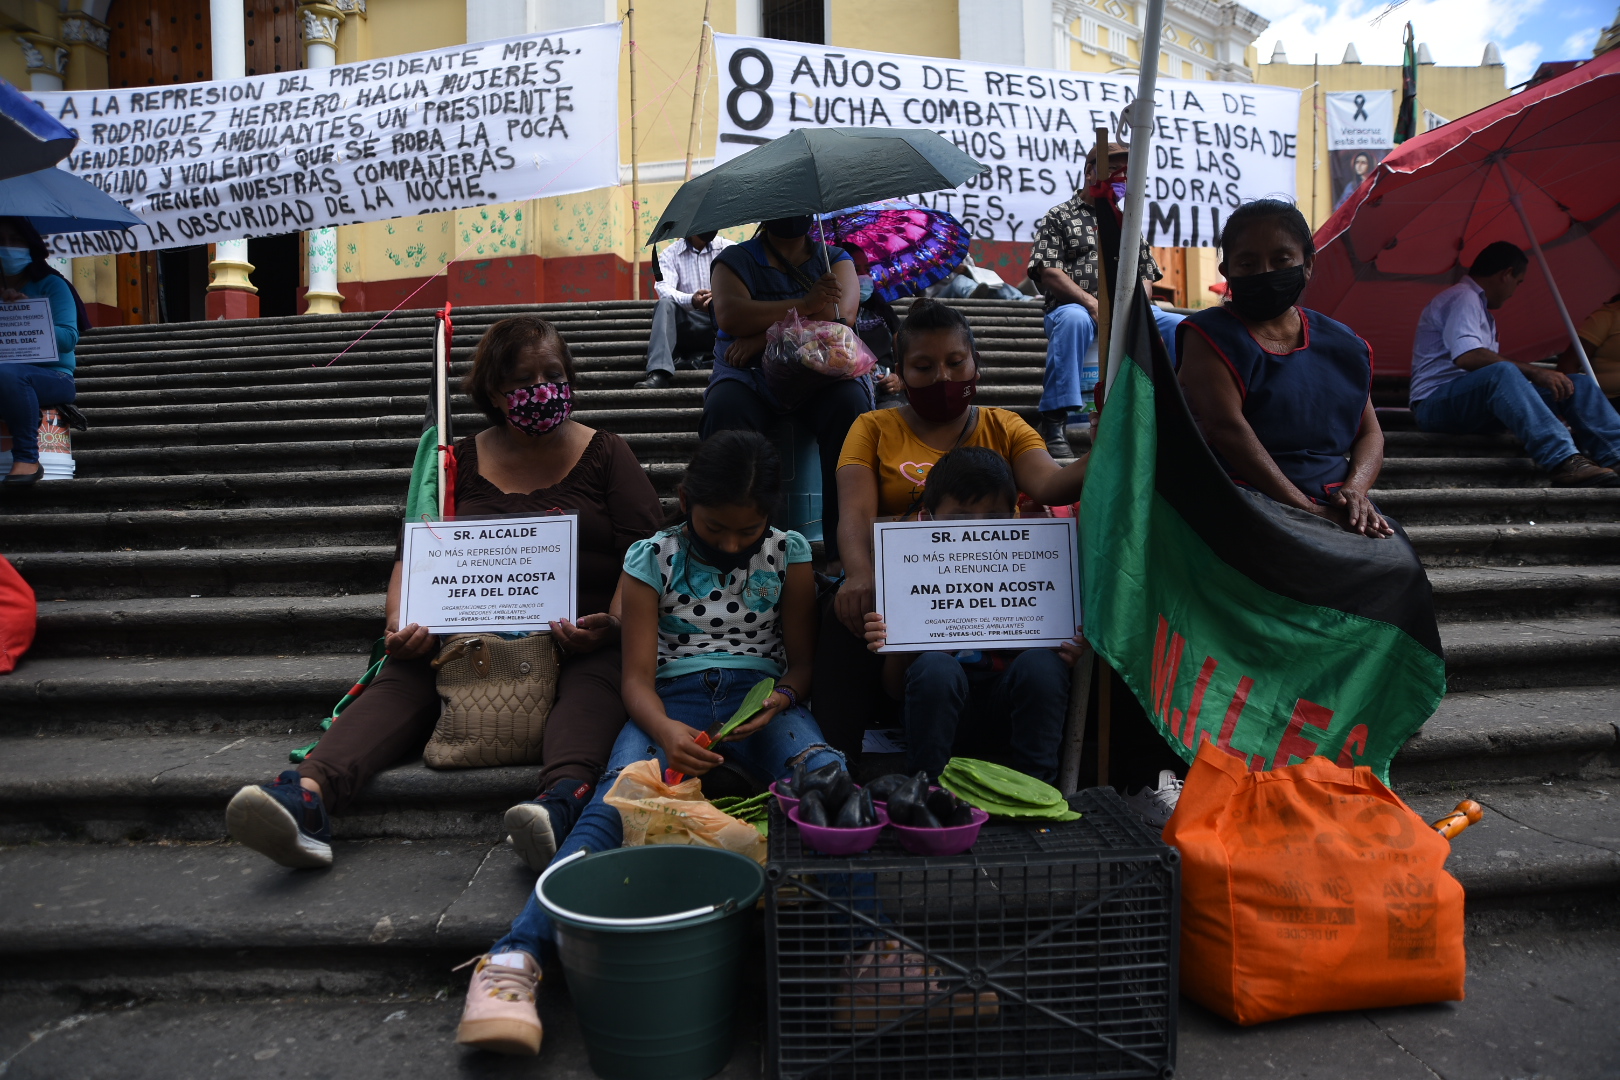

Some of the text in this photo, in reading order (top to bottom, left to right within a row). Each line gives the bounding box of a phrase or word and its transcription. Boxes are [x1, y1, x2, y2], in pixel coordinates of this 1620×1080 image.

[59, 96, 78, 119] A
[91, 95, 120, 117] LA
[131, 81, 265, 113] REPRESION
[276, 75, 315, 96] DEL
[329, 47, 484, 87] PRESIDENTE
[502, 37, 581, 61] MPAL.
[790, 53, 901, 91] AÑOS
[922, 65, 968, 93] DE
[1222, 92, 1257, 116] DE
[726, 47, 774, 131] 8
[91, 111, 216, 145] RODRIGUEZ
[229, 92, 340, 128] HERRERO
[356, 79, 429, 107] HACIA
[440, 59, 564, 95] MUJERES
[67, 137, 204, 171] VENDEDORAS
[377, 108, 408, 129] UN
[423, 86, 574, 125] PRESIDENTE
[789, 91, 892, 127] LUCHA
[903, 97, 1078, 134] COMBATIVA
[1150, 116, 1266, 155] EFENSA
[1269, 130, 1298, 159] DE
[179, 153, 281, 185] VIOLENTO
[295, 143, 336, 171] QUE
[345, 137, 381, 160] SE
[392, 128, 446, 155] ROBA
[458, 121, 490, 149] LA
[508, 114, 569, 141] POCA
[1155, 144, 1185, 170] DE
[1196, 148, 1242, 181] LAS
[146, 146, 516, 212] TIENEN NUESTRAS COMPAÑERAS
[149, 222, 175, 244] LA
[177, 199, 314, 239] OBSCURIDAD
[325, 195, 356, 218] DE
[362, 186, 394, 209] LA
[406, 174, 497, 200] NOCHE.
[453, 528, 538, 541] SR. ALCALDE
[931, 530, 1030, 543] SR. ALCALDE
[428, 544, 561, 558] NO MÁS REPRESIÓN PEDIMOS
[903, 549, 1059, 563] NO MÁS REPRESIÓN PEDIMOS
[456, 557, 532, 568] LA RENUNCIA DE
[938, 563, 1026, 574] LA RENUNCIA DE
[431, 572, 556, 585] ANA DIXON ACOSTA
[447, 586, 539, 598] JEFA DEL DIAC
[910, 581, 1055, 595] ANA DIXON ACOSTA
[930, 596, 1037, 610] JEFA DEL DIAC
[924, 617, 978, 625] ORGANIZACIONES
